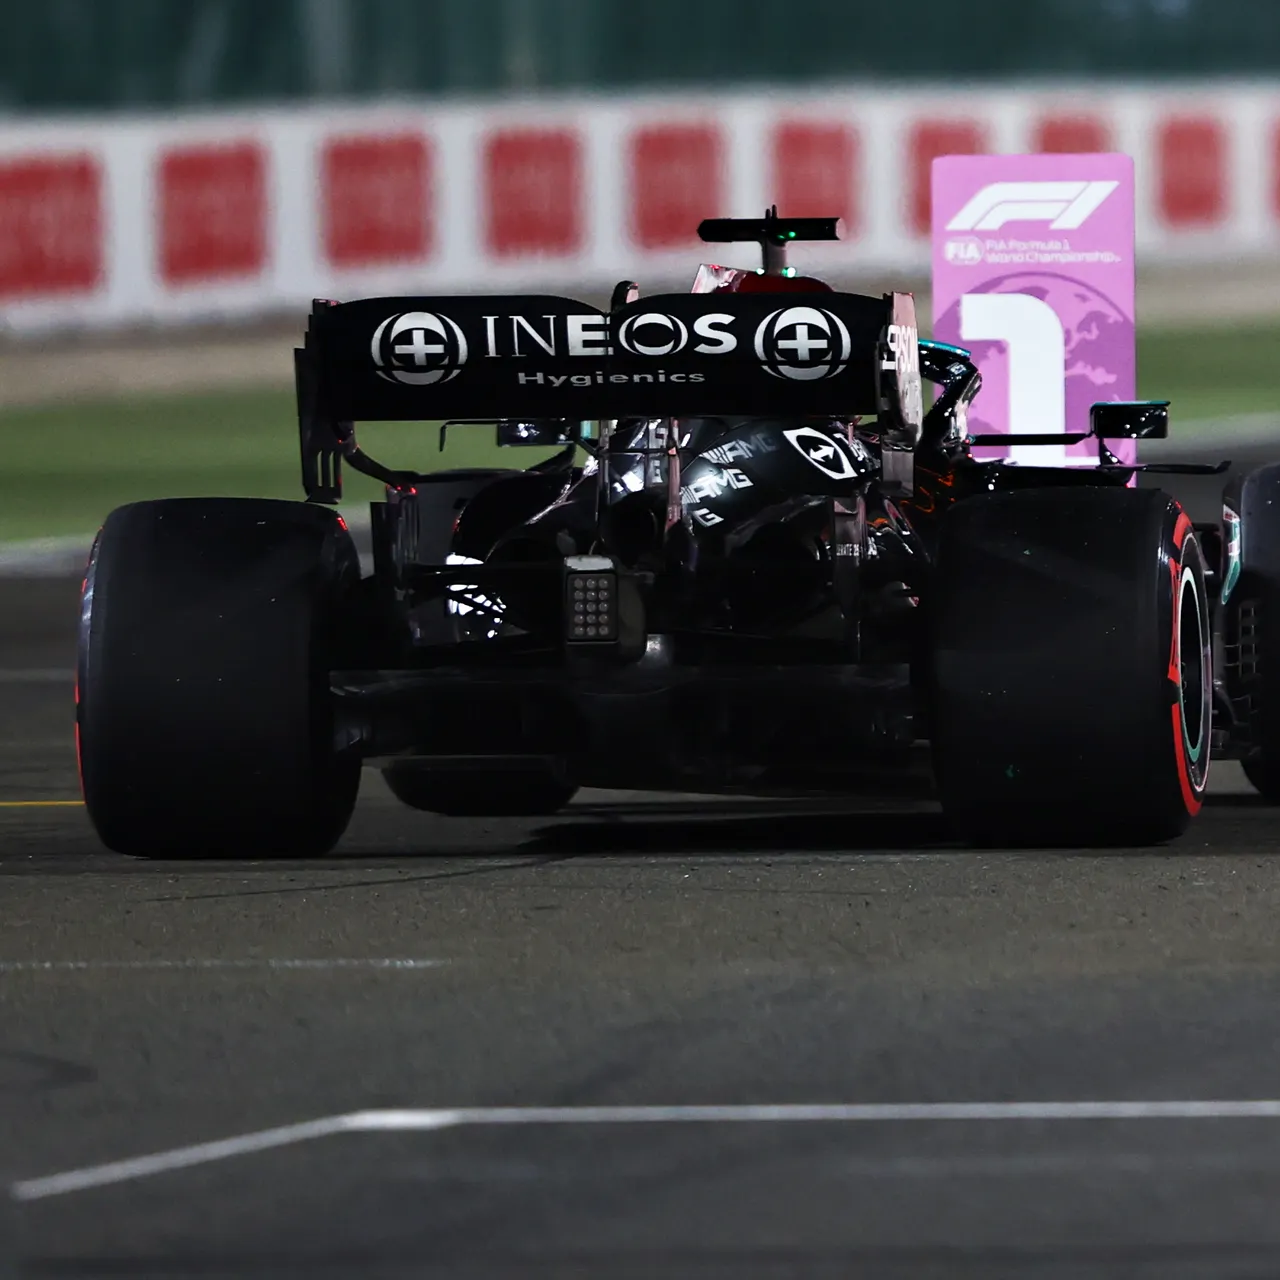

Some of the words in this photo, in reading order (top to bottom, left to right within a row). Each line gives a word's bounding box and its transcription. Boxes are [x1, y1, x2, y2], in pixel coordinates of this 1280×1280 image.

[944, 181, 1120, 231] F1
[482, 313, 738, 358] INEOS
[518, 369, 706, 387] Hygienics
[961, 293, 1100, 467] 1
